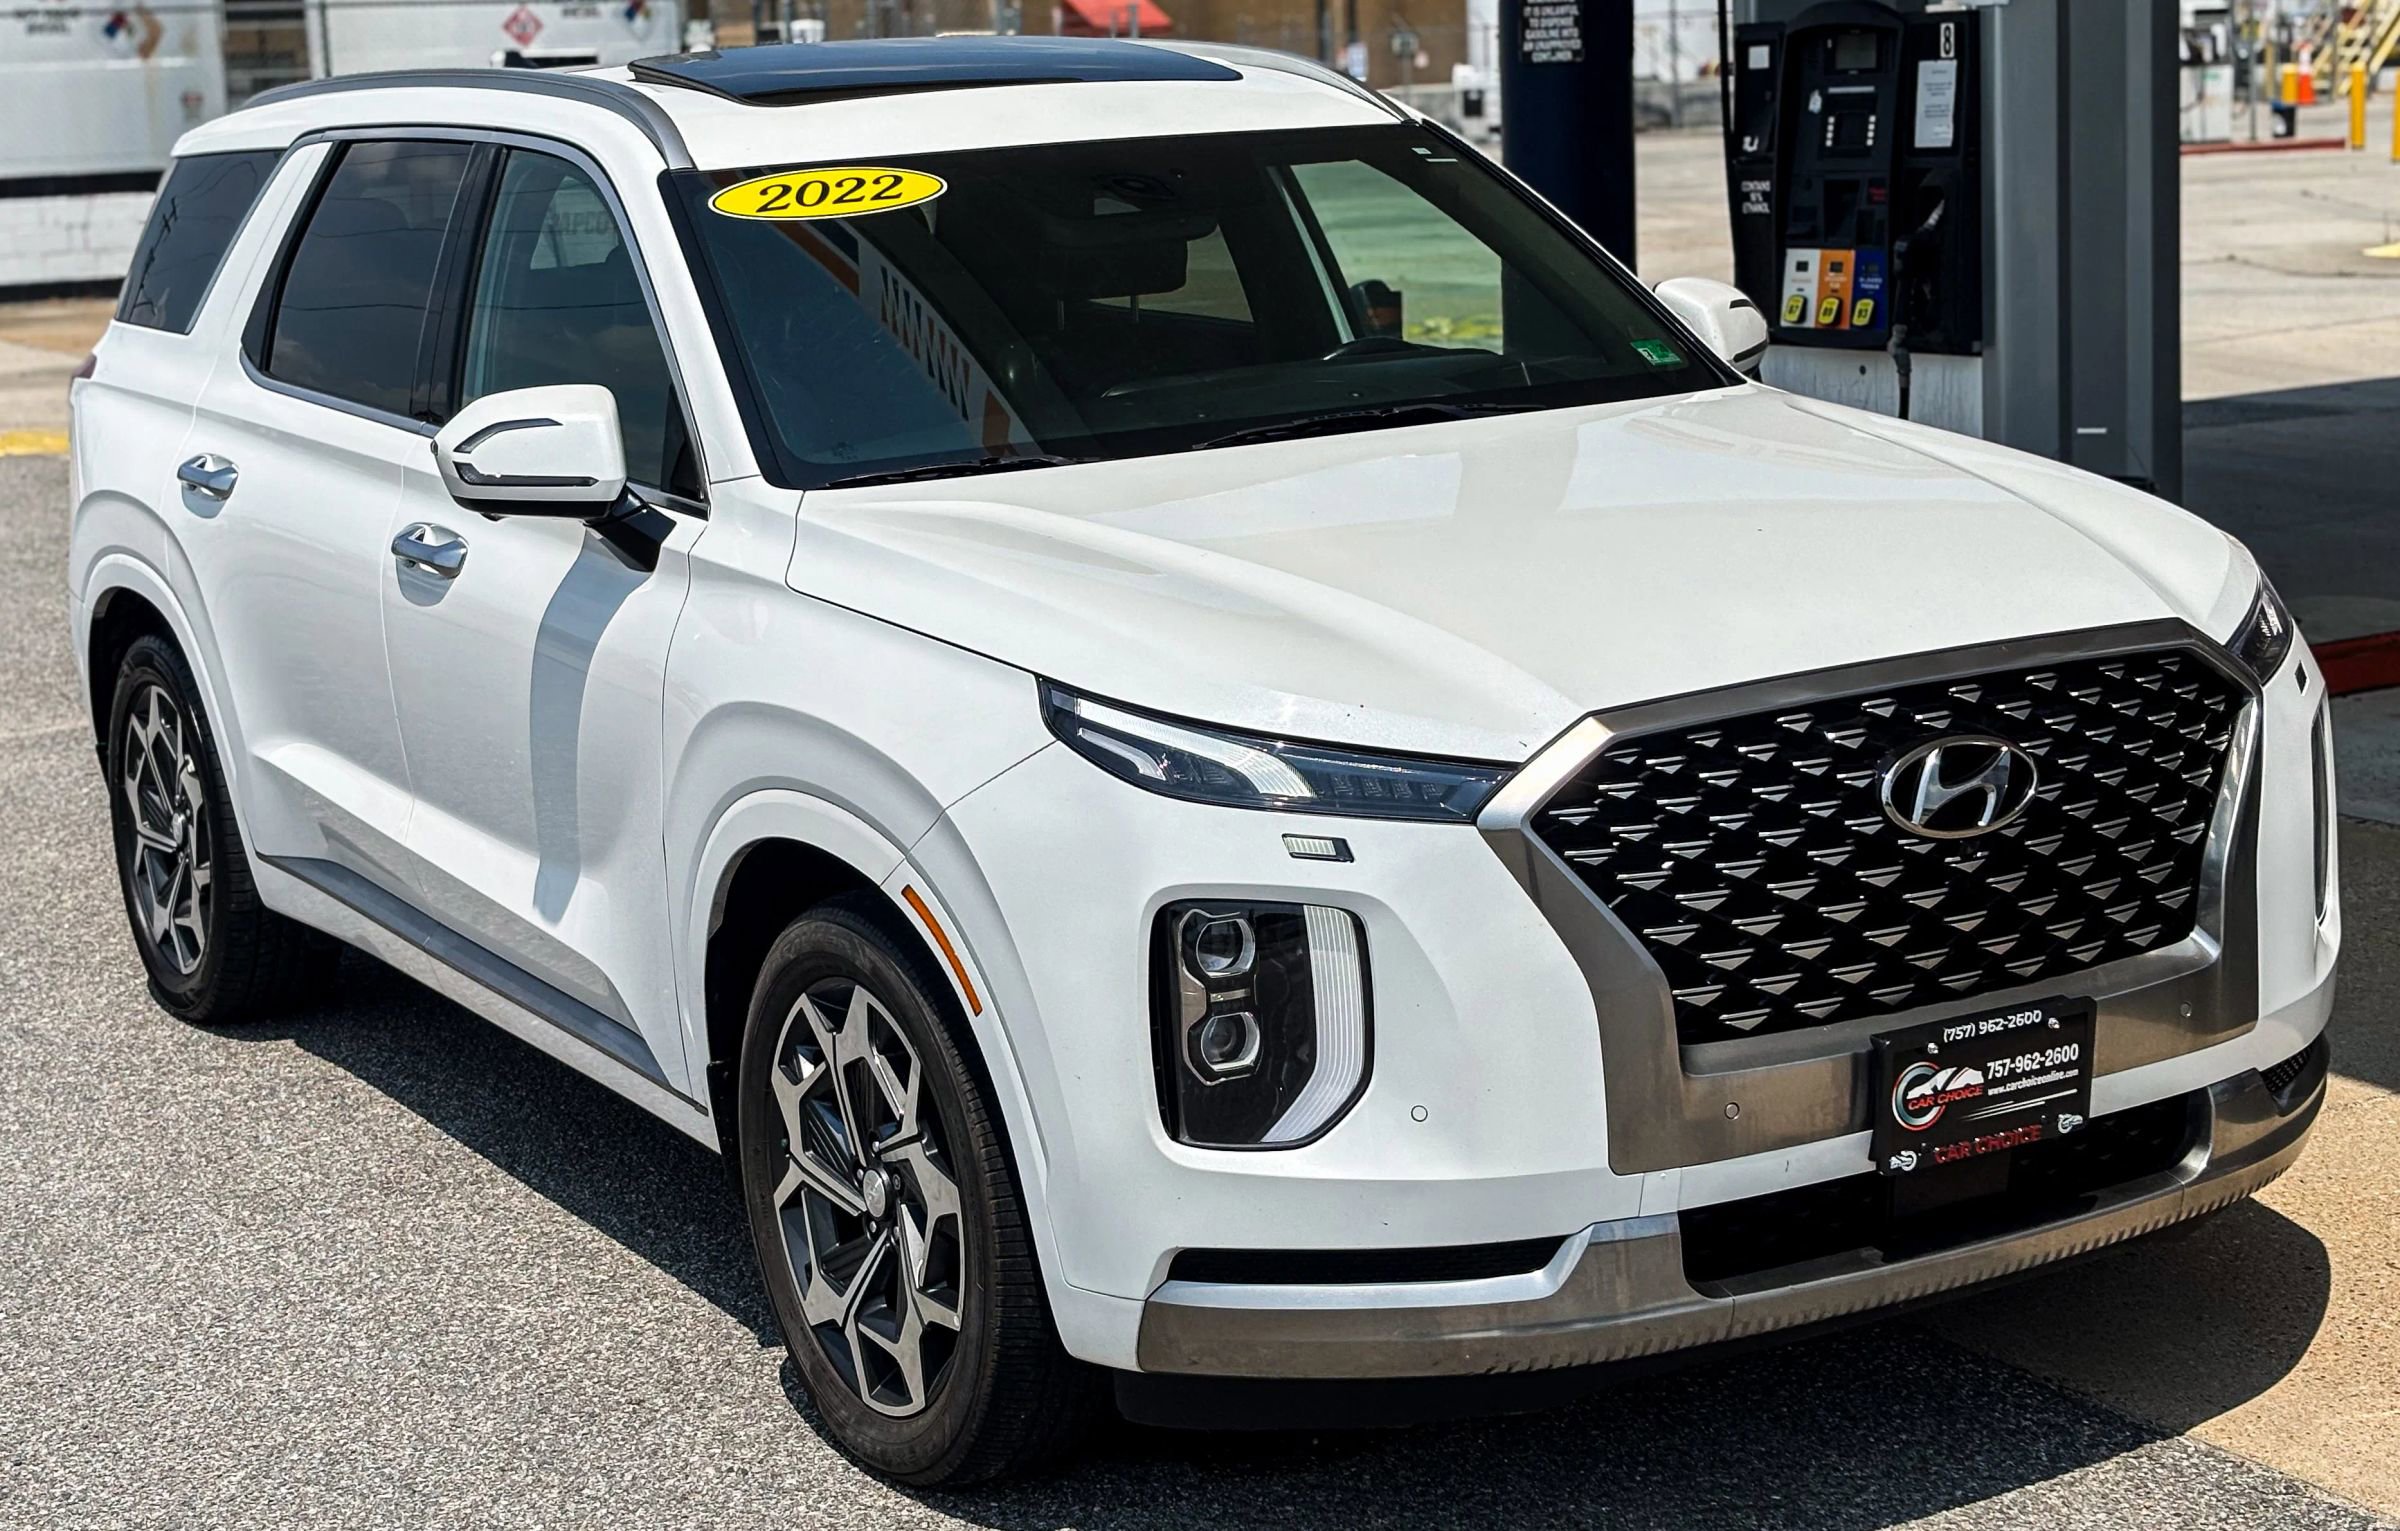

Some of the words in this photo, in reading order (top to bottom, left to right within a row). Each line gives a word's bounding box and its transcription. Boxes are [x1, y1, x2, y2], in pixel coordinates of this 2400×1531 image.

[1943, 25, 1952, 55] 8
[756, 174, 903, 213] 2022
[1943, 1022, 1976, 1044] (757)
[1978, 1009, 2042, 1036] 962-2600
[1986, 1043, 2079, 1080] 757-962-2600
[1908, 1096, 1935, 1111] CAR
[1937, 1084, 1984, 1104] CHOICE
[1933, 1142, 1972, 1164] CAR
[1975, 1124, 2043, 1154] CHOICE
